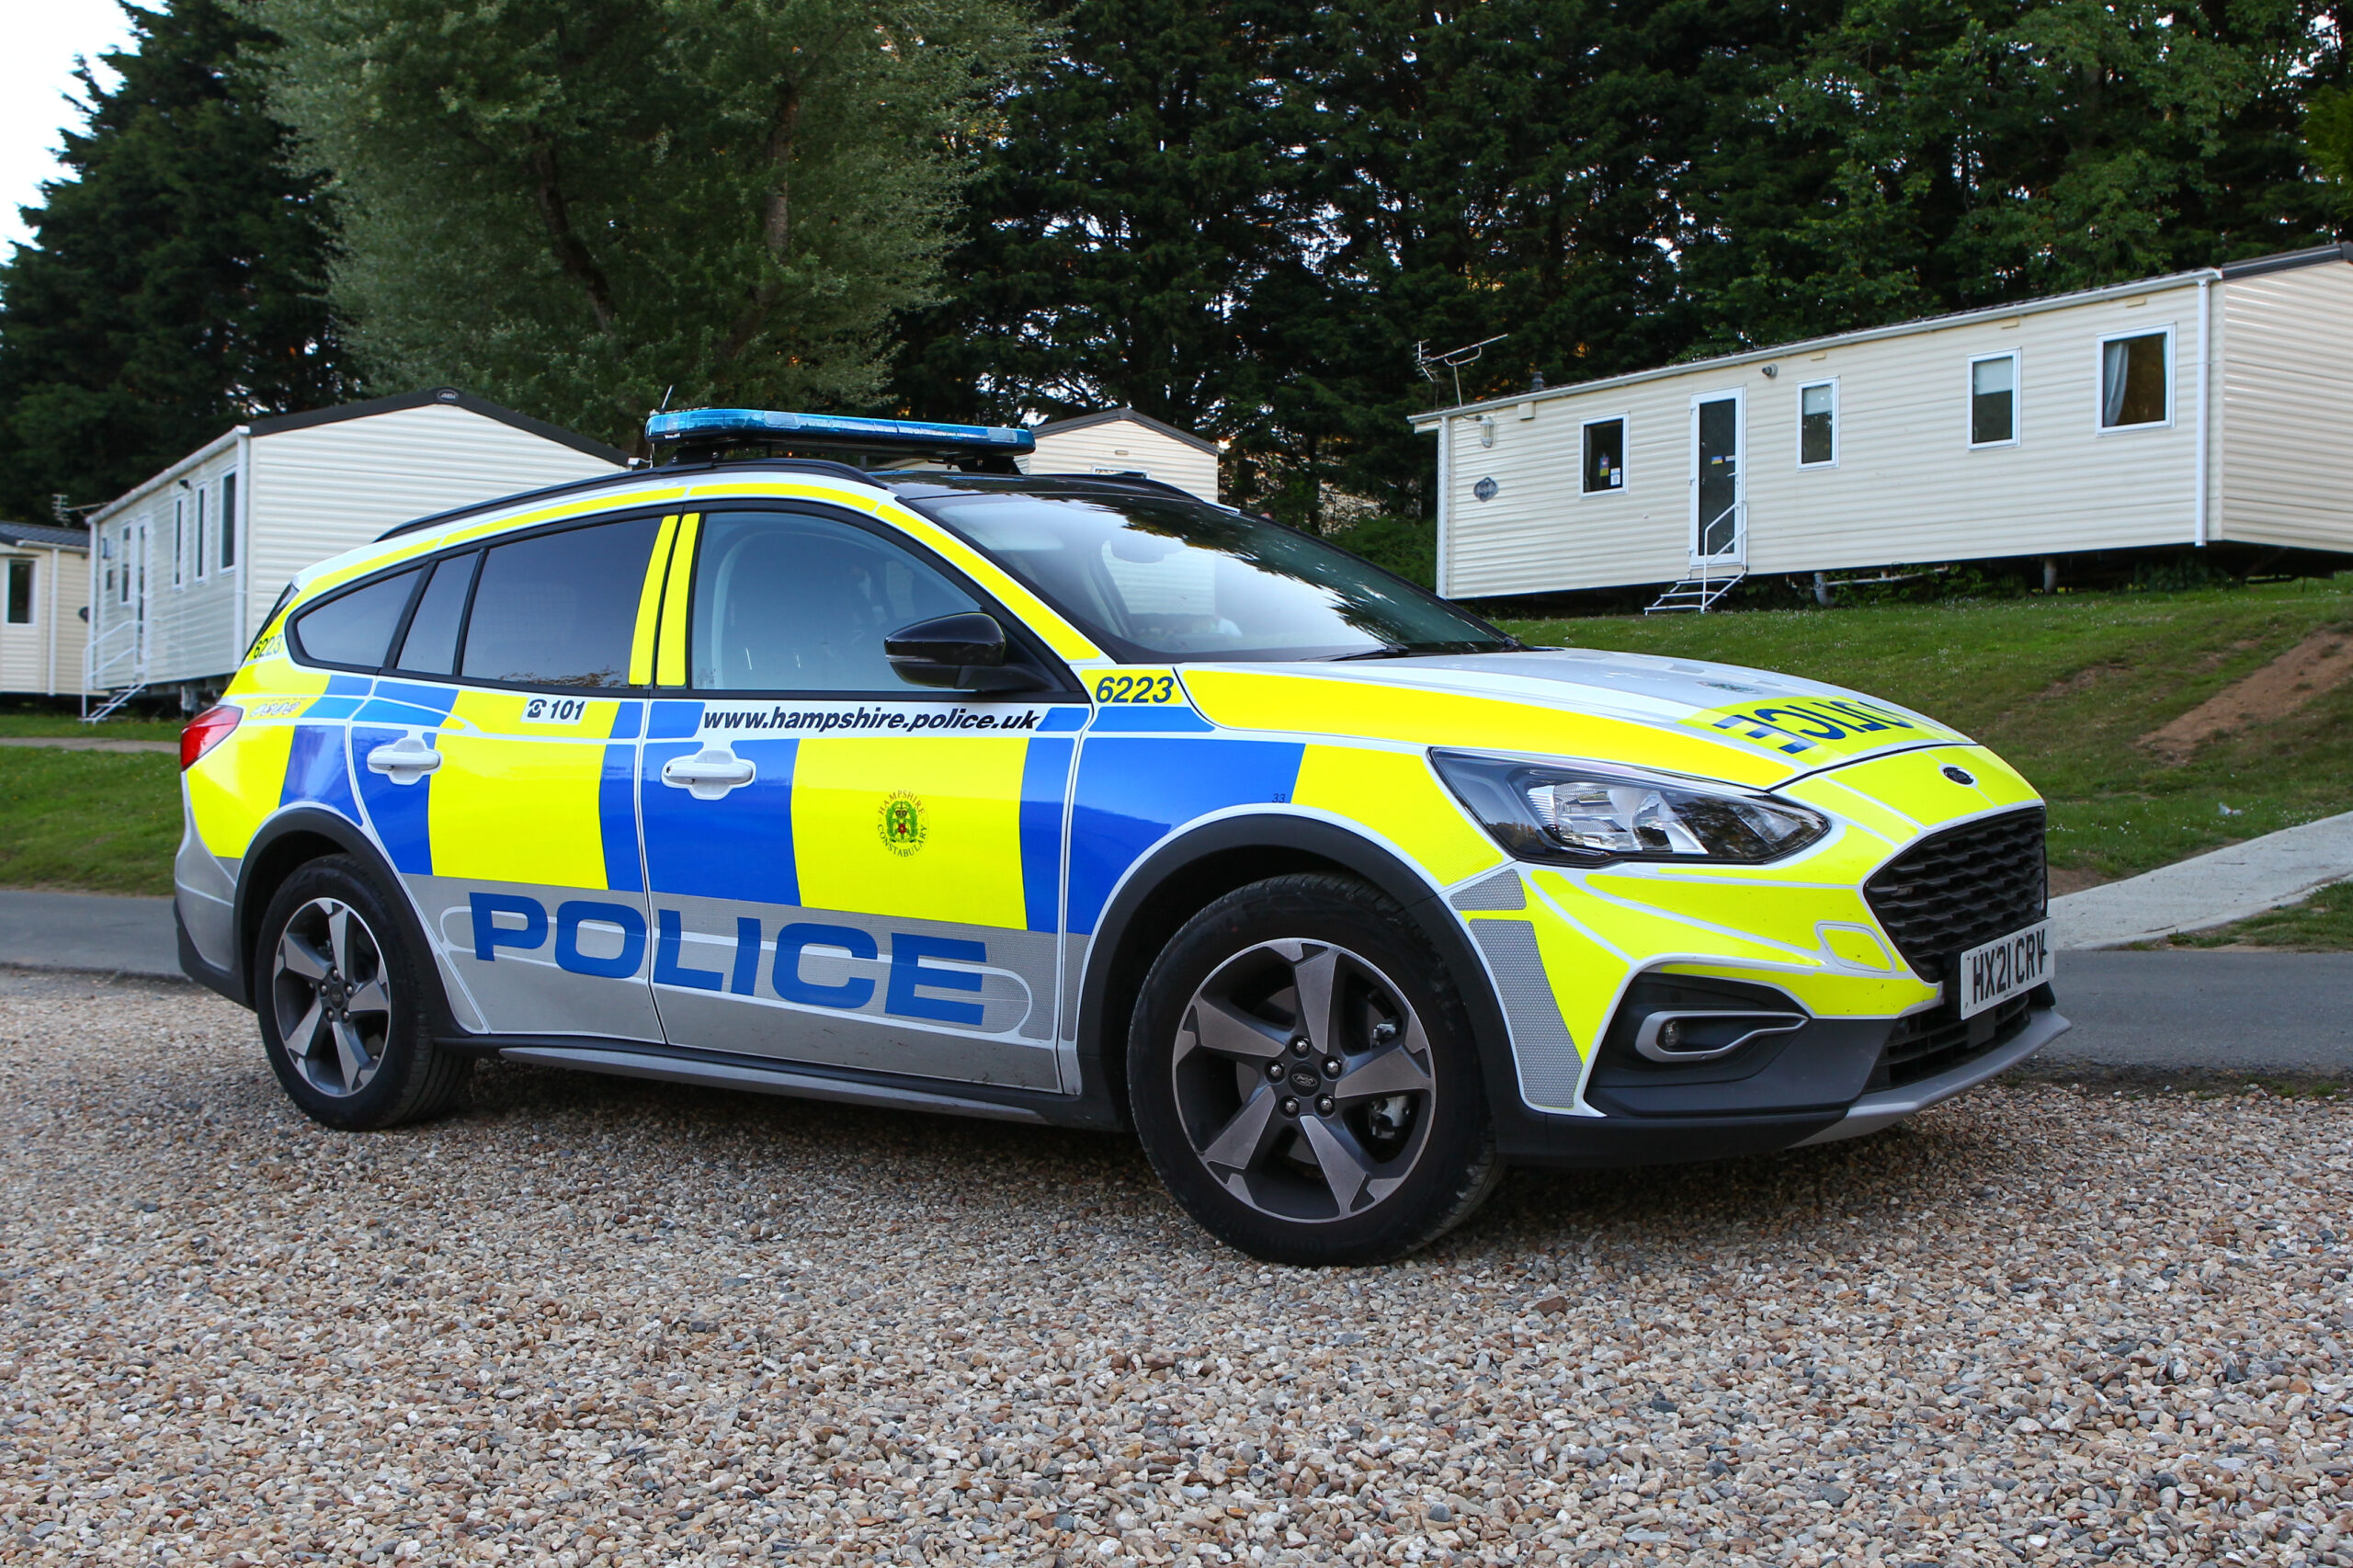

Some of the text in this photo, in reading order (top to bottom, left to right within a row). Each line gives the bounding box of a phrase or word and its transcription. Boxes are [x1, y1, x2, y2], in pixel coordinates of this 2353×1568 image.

[254, 634, 283, 659] 6223
[1096, 676, 1174, 703] 6223
[551, 699, 585, 720] 101
[704, 706, 1040, 733] www.hampshire.police.uk
[878, 790, 926, 816] HAMPSHIRE
[877, 824, 927, 858] CONSTABULARY
[469, 892, 987, 1026] POLICE
[1973, 928, 2045, 1005] HX21 CRV
